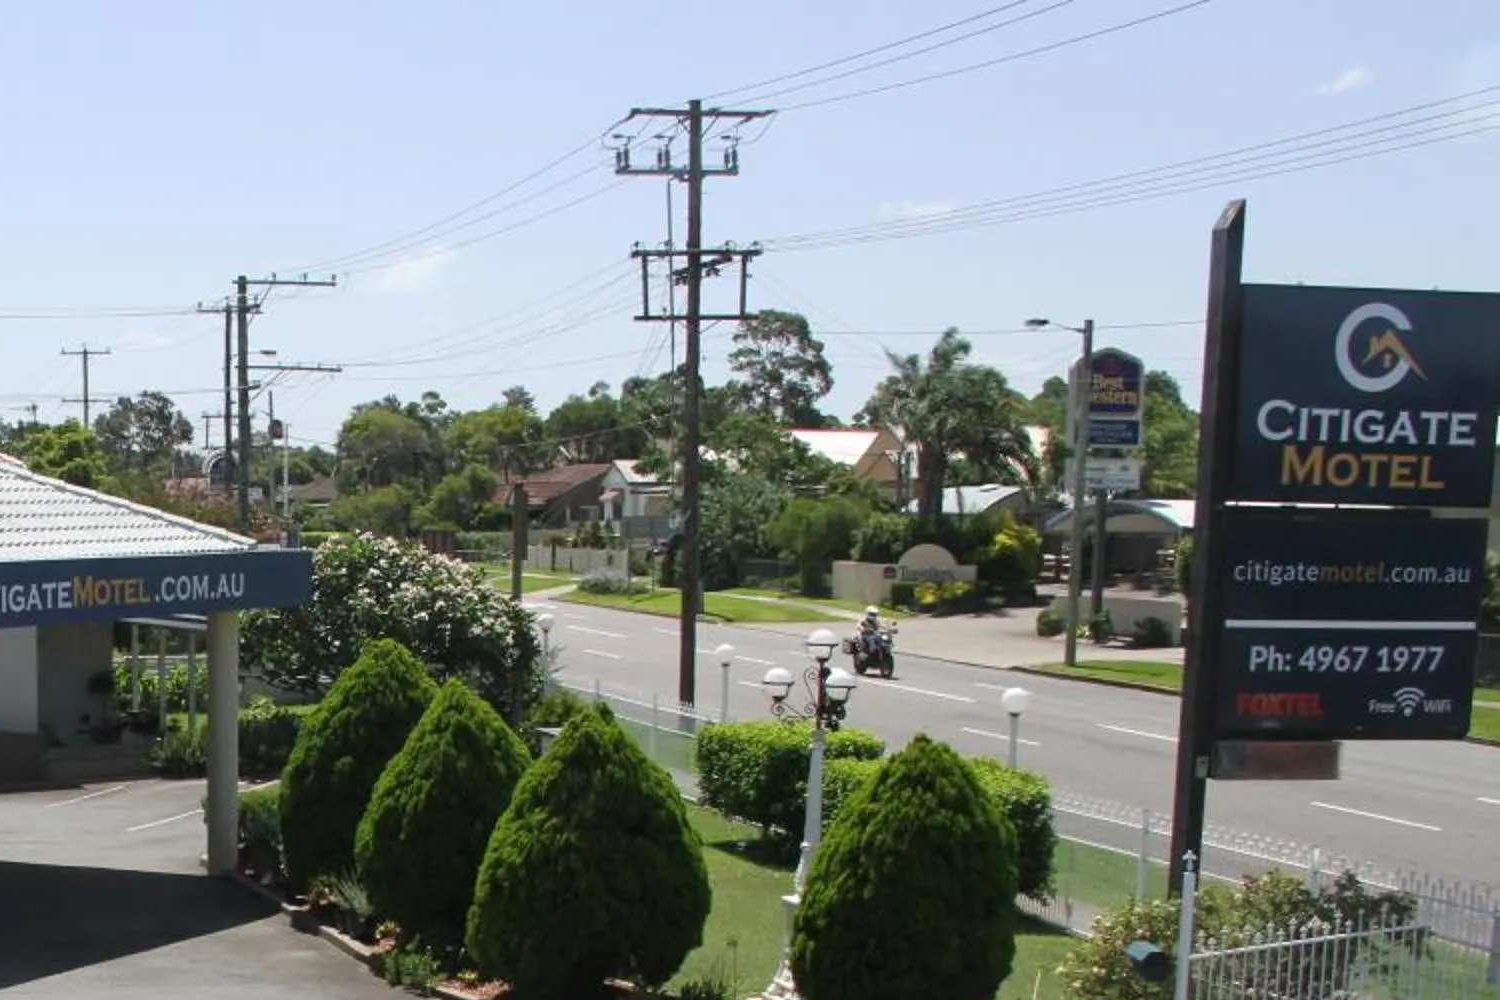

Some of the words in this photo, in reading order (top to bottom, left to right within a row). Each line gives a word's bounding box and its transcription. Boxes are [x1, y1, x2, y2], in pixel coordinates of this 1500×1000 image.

[1093, 373, 1124, 390] Best
[1092, 391, 1138, 405] estern
[1257, 399, 1478, 446] CITIGATE
[1280, 444, 1446, 489] MOTEL
[1233, 560, 1471, 585] citigatemotel.com.au
[1249, 645, 1292, 673] Ph:
[1298, 645, 1369, 673] 4967
[1376, 646, 1445, 673] 1977
[1237, 692, 1324, 716] FOXTEL
[1368, 699, 1397, 713] Free
